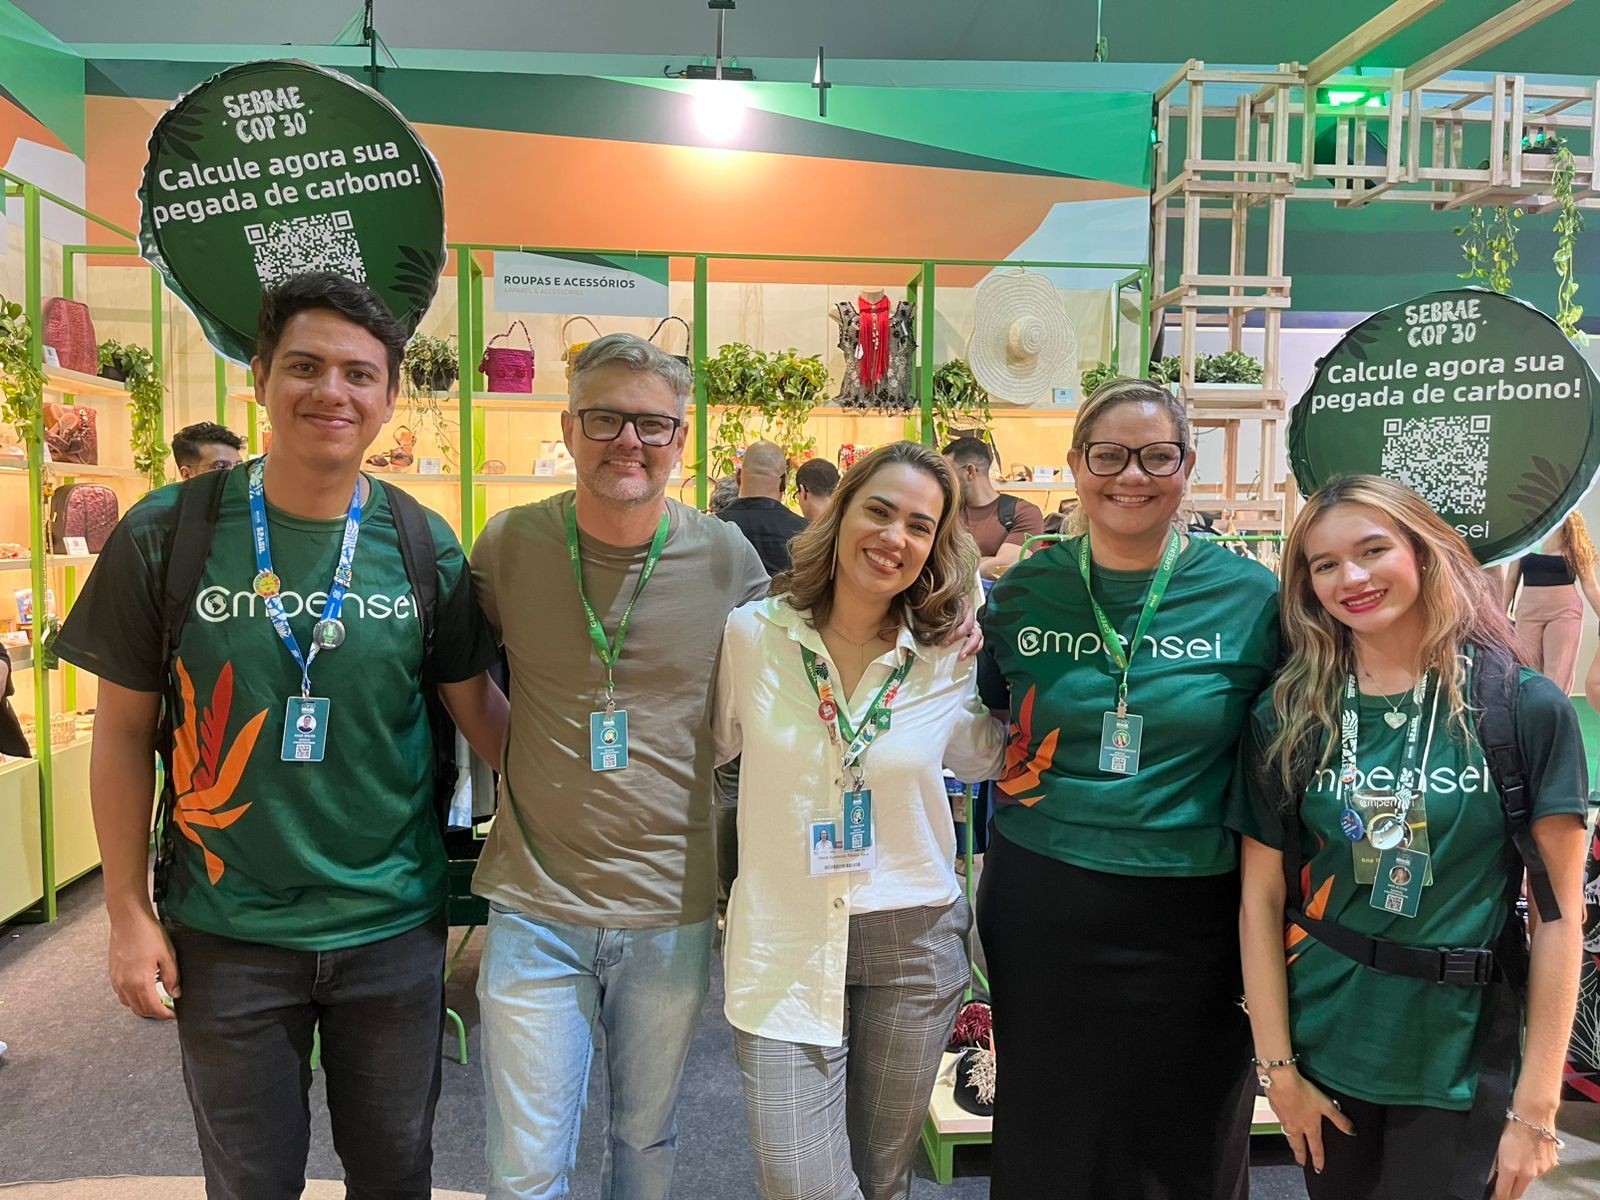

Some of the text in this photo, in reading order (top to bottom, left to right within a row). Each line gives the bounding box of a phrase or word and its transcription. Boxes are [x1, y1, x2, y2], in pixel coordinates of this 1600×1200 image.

[222, 86, 305, 119] SEBRAE
[236, 112, 307, 144] COP 30
[158, 141, 400, 192] Calcule agora sua
[152, 164, 422, 229] pegada de carbono!
[504, 275, 636, 289] ROUPAS E ACESSÓRIOS
[1404, 298, 1482, 326] SEBRAE
[1407, 321, 1477, 348] COP 30
[1327, 354, 1565, 385] Calcule agora sua
[1311, 378, 1582, 414] pegada de carbono!
[1163, 546, 1179, 571] GREEN
